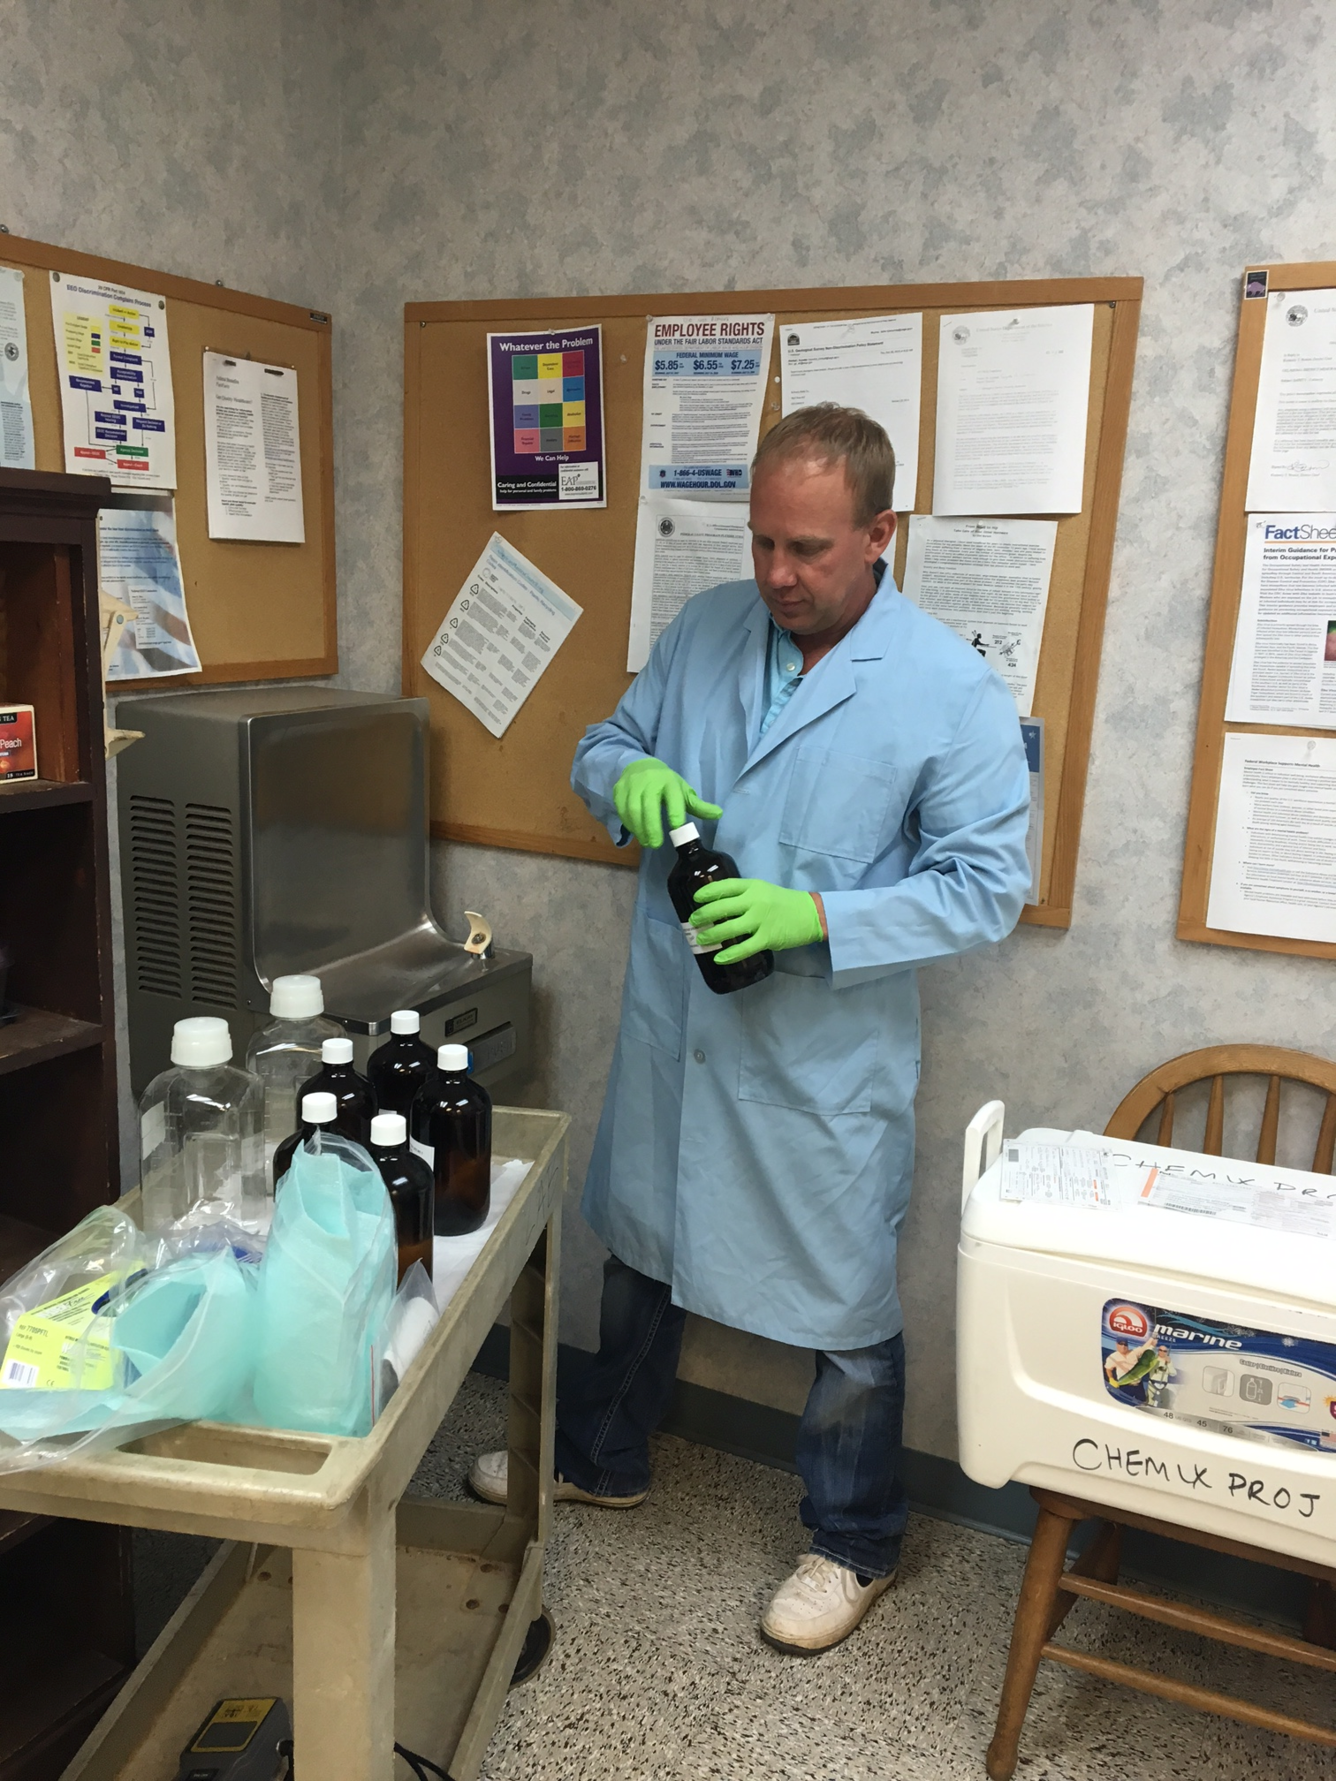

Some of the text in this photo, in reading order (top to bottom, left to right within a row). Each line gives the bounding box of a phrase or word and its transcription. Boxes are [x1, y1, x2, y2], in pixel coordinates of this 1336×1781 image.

[78, 287, 113, 299] Discrimination
[654, 322, 765, 337] EMPLOYEE RIGHTS
[499, 337, 593, 352] Whatever the Problem
[655, 360, 754, 371] $5.85 $6.55 $7.25
[561, 476, 579, 486] EAP
[1265, 524, 1336, 540] FactShee
[0, 738, 22, 749] Peach
[1112, 1321, 1143, 1334] IGLOO
[1155, 1323, 1243, 1350] marine
[1156, 1335, 1176, 1343] EEZE
[1163, 1411, 1174, 1419] 48
[1223, 1425, 1233, 1434] 76
[1228, 1472, 1321, 1518] PROJ
